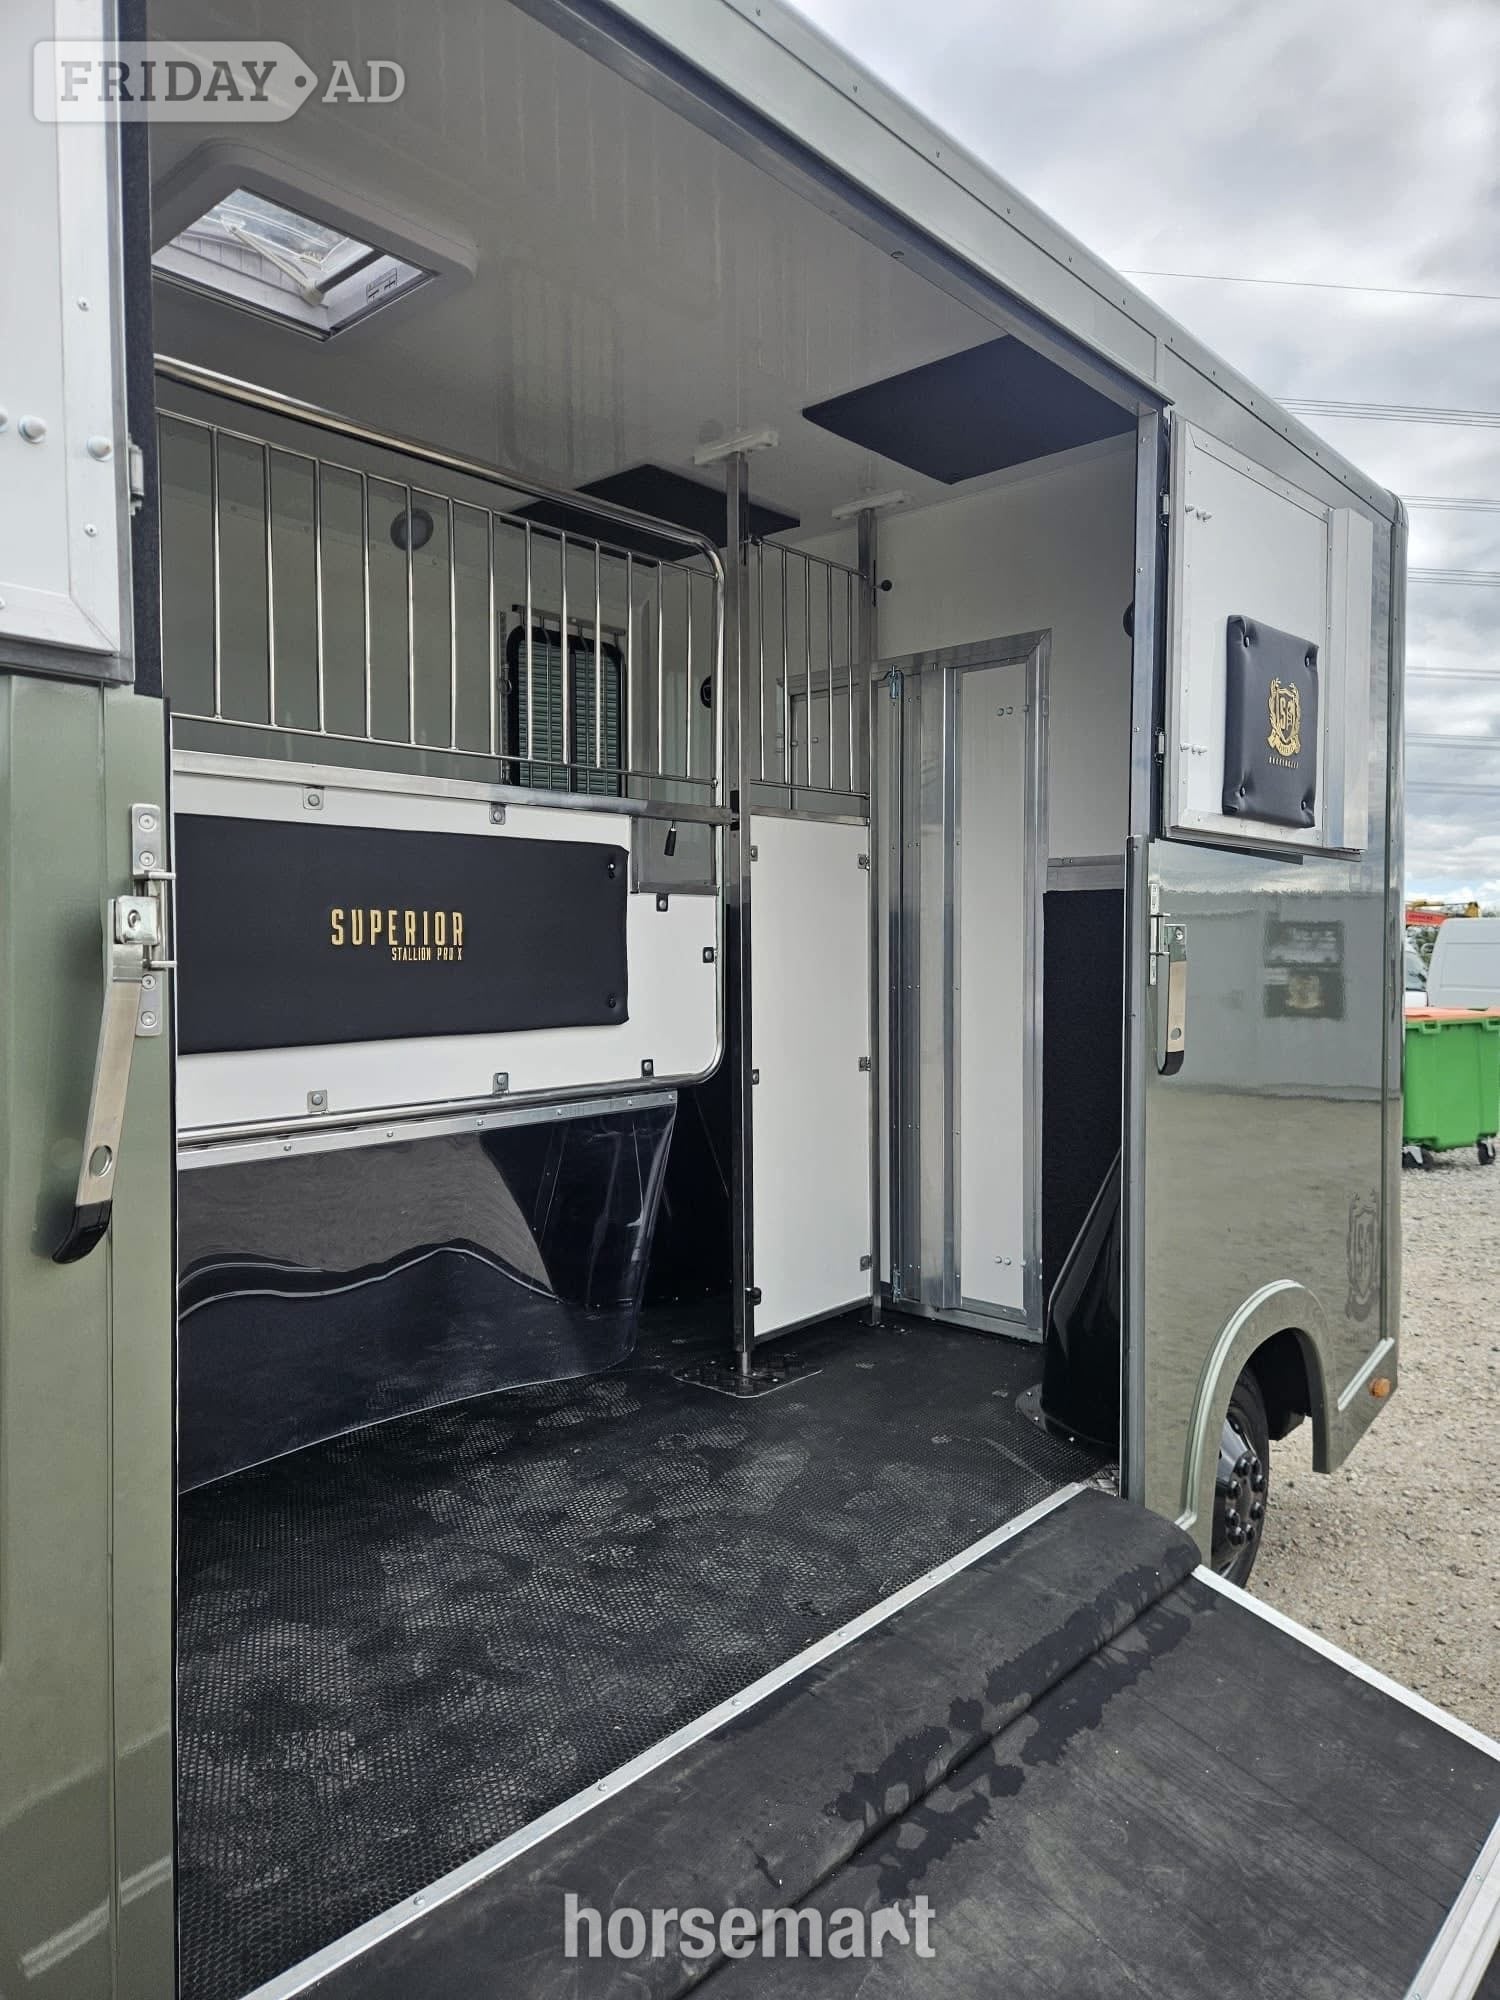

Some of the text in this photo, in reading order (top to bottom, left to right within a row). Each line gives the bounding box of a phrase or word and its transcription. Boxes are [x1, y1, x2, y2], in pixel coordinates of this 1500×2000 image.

[331, 908, 463, 946] SUPERIOR
[391, 947, 463, 961] STALLION PRO X
